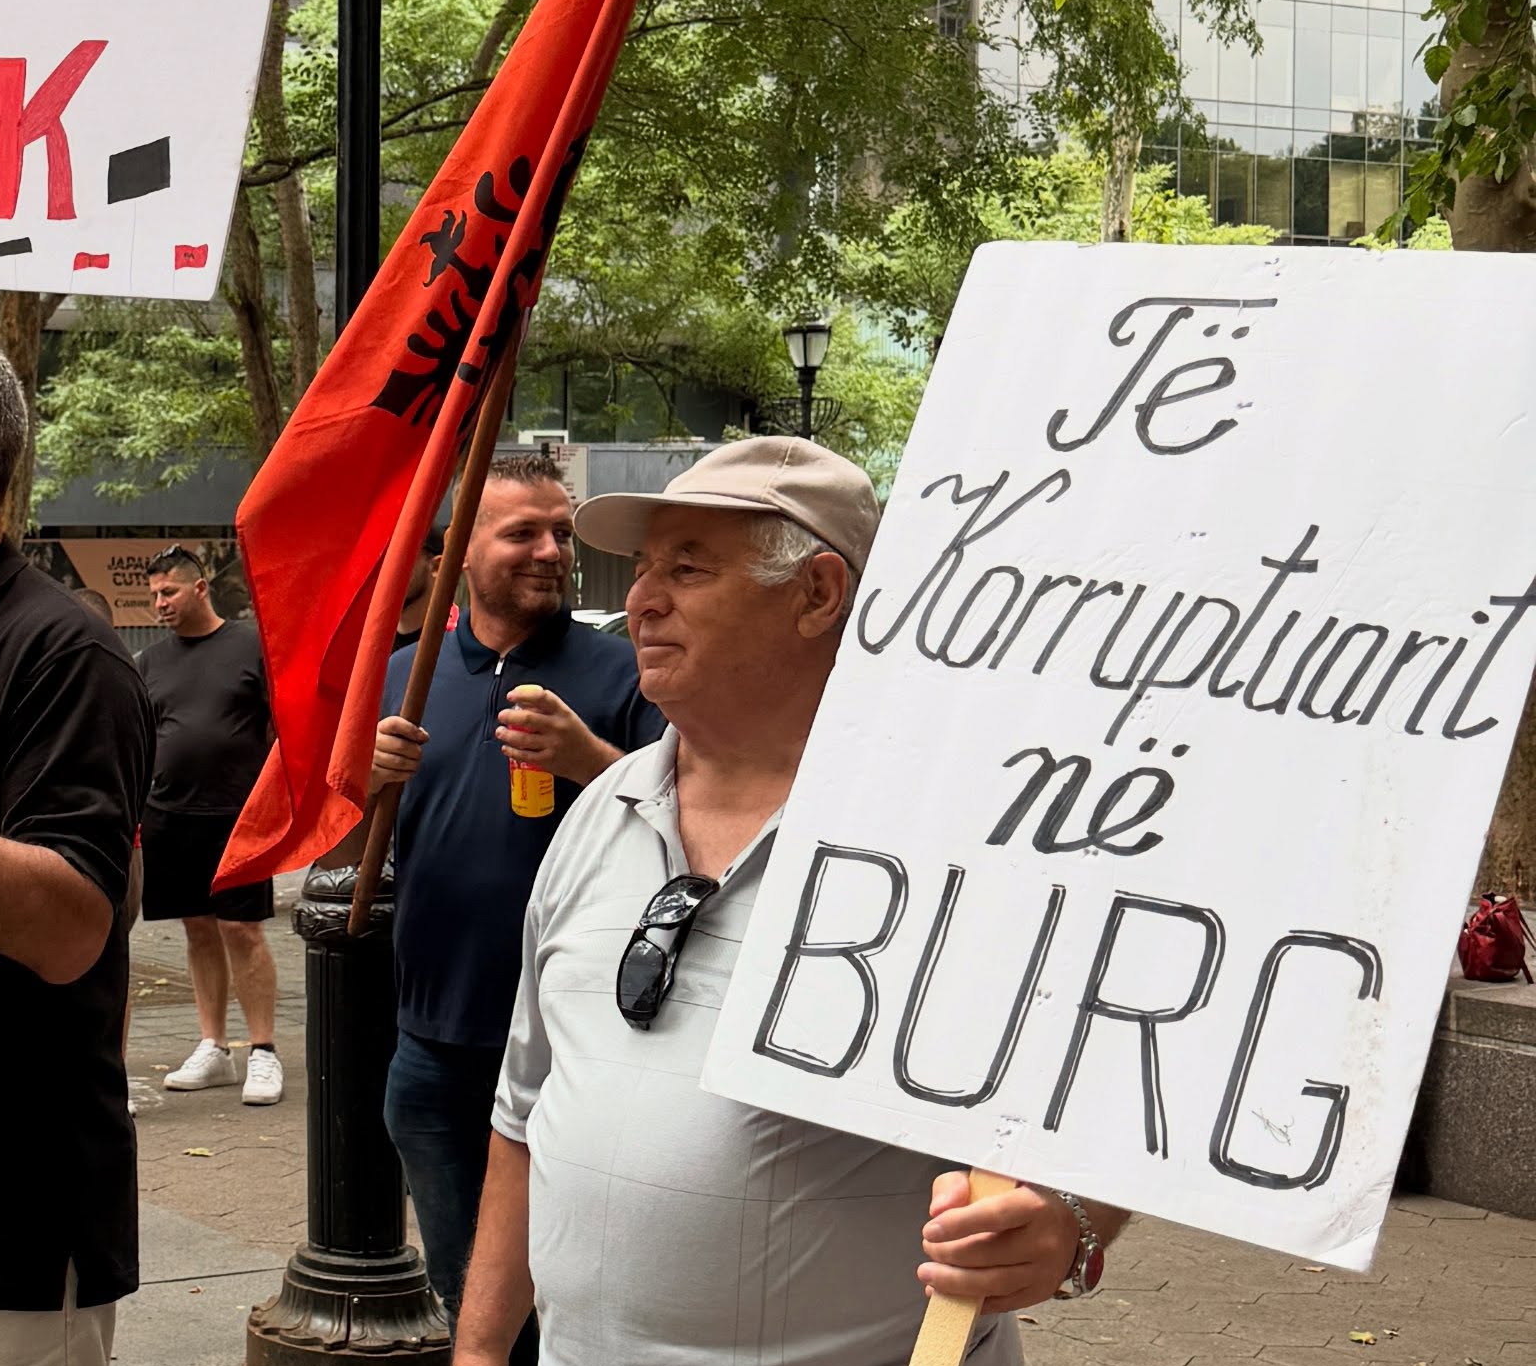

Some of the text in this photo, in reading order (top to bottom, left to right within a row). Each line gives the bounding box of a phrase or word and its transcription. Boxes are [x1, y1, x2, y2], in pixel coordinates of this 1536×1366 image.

[1046, 297, 1278, 456] Të
[857, 468, 1536, 746] Korruptuarit
[985, 735, 1190, 857] në
[752, 839, 1384, 1192] BURG
